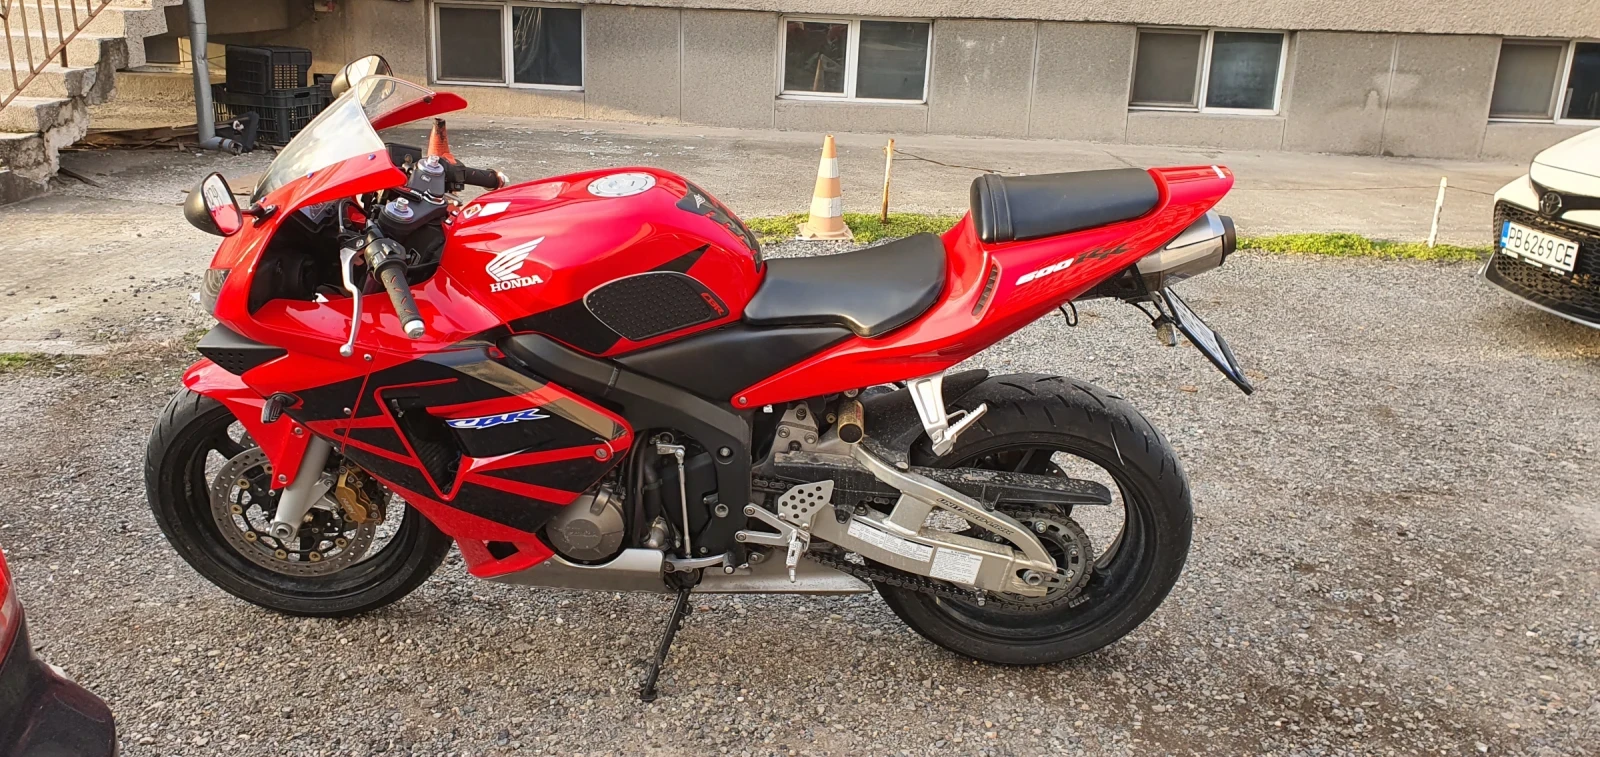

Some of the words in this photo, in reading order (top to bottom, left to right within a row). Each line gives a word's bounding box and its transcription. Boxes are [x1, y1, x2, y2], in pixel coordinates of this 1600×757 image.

[1509, 227, 1523, 248] PB
[1523, 233, 1554, 259] 6269
[1555, 243, 1575, 267] CE
[490, 274, 544, 293] HONDA
[1015, 257, 1075, 286] 600
[701, 292, 725, 316] CBR
[445, 408, 550, 430] CBR
